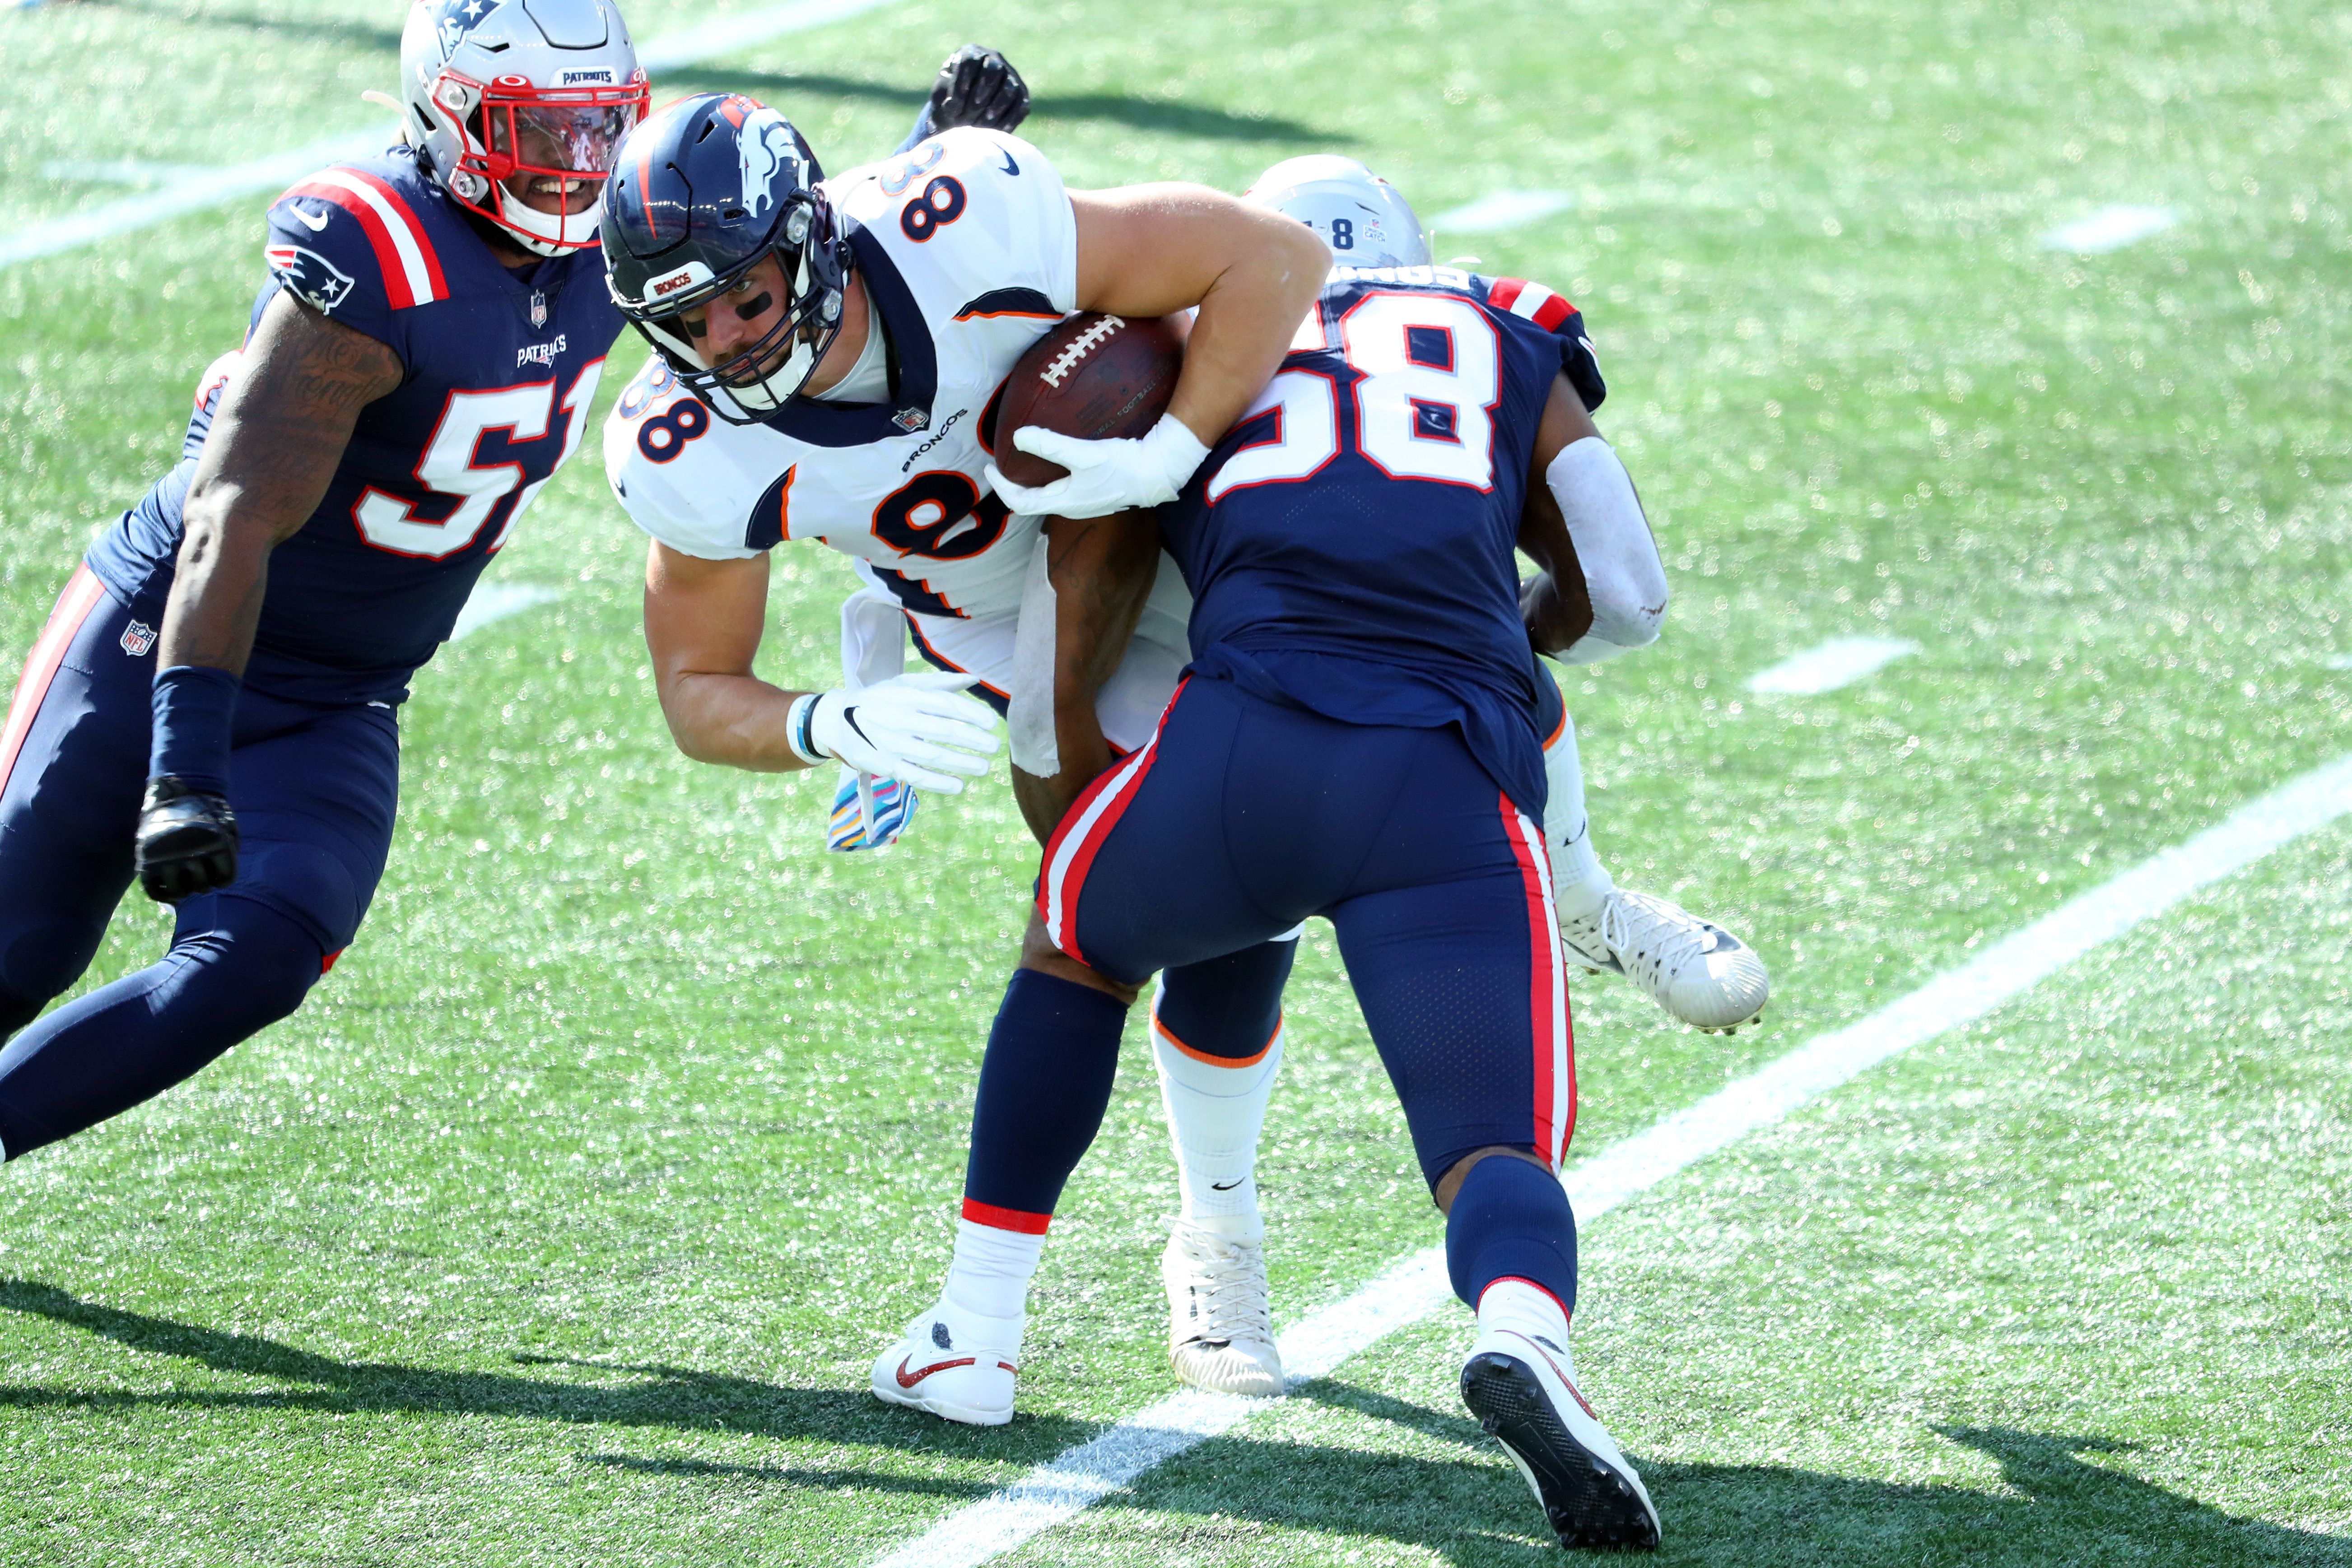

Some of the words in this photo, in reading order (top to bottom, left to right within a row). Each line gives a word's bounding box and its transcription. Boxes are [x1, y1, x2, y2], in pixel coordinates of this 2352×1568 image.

[1365, 231, 1385, 242] CATCH
[653, 272, 691, 296] BRONCOS
[1204, 291, 1503, 507] 58
[351, 355, 606, 562] 51
[902, 409, 968, 472] BRONCOS
[124, 633, 144, 651] NFL
